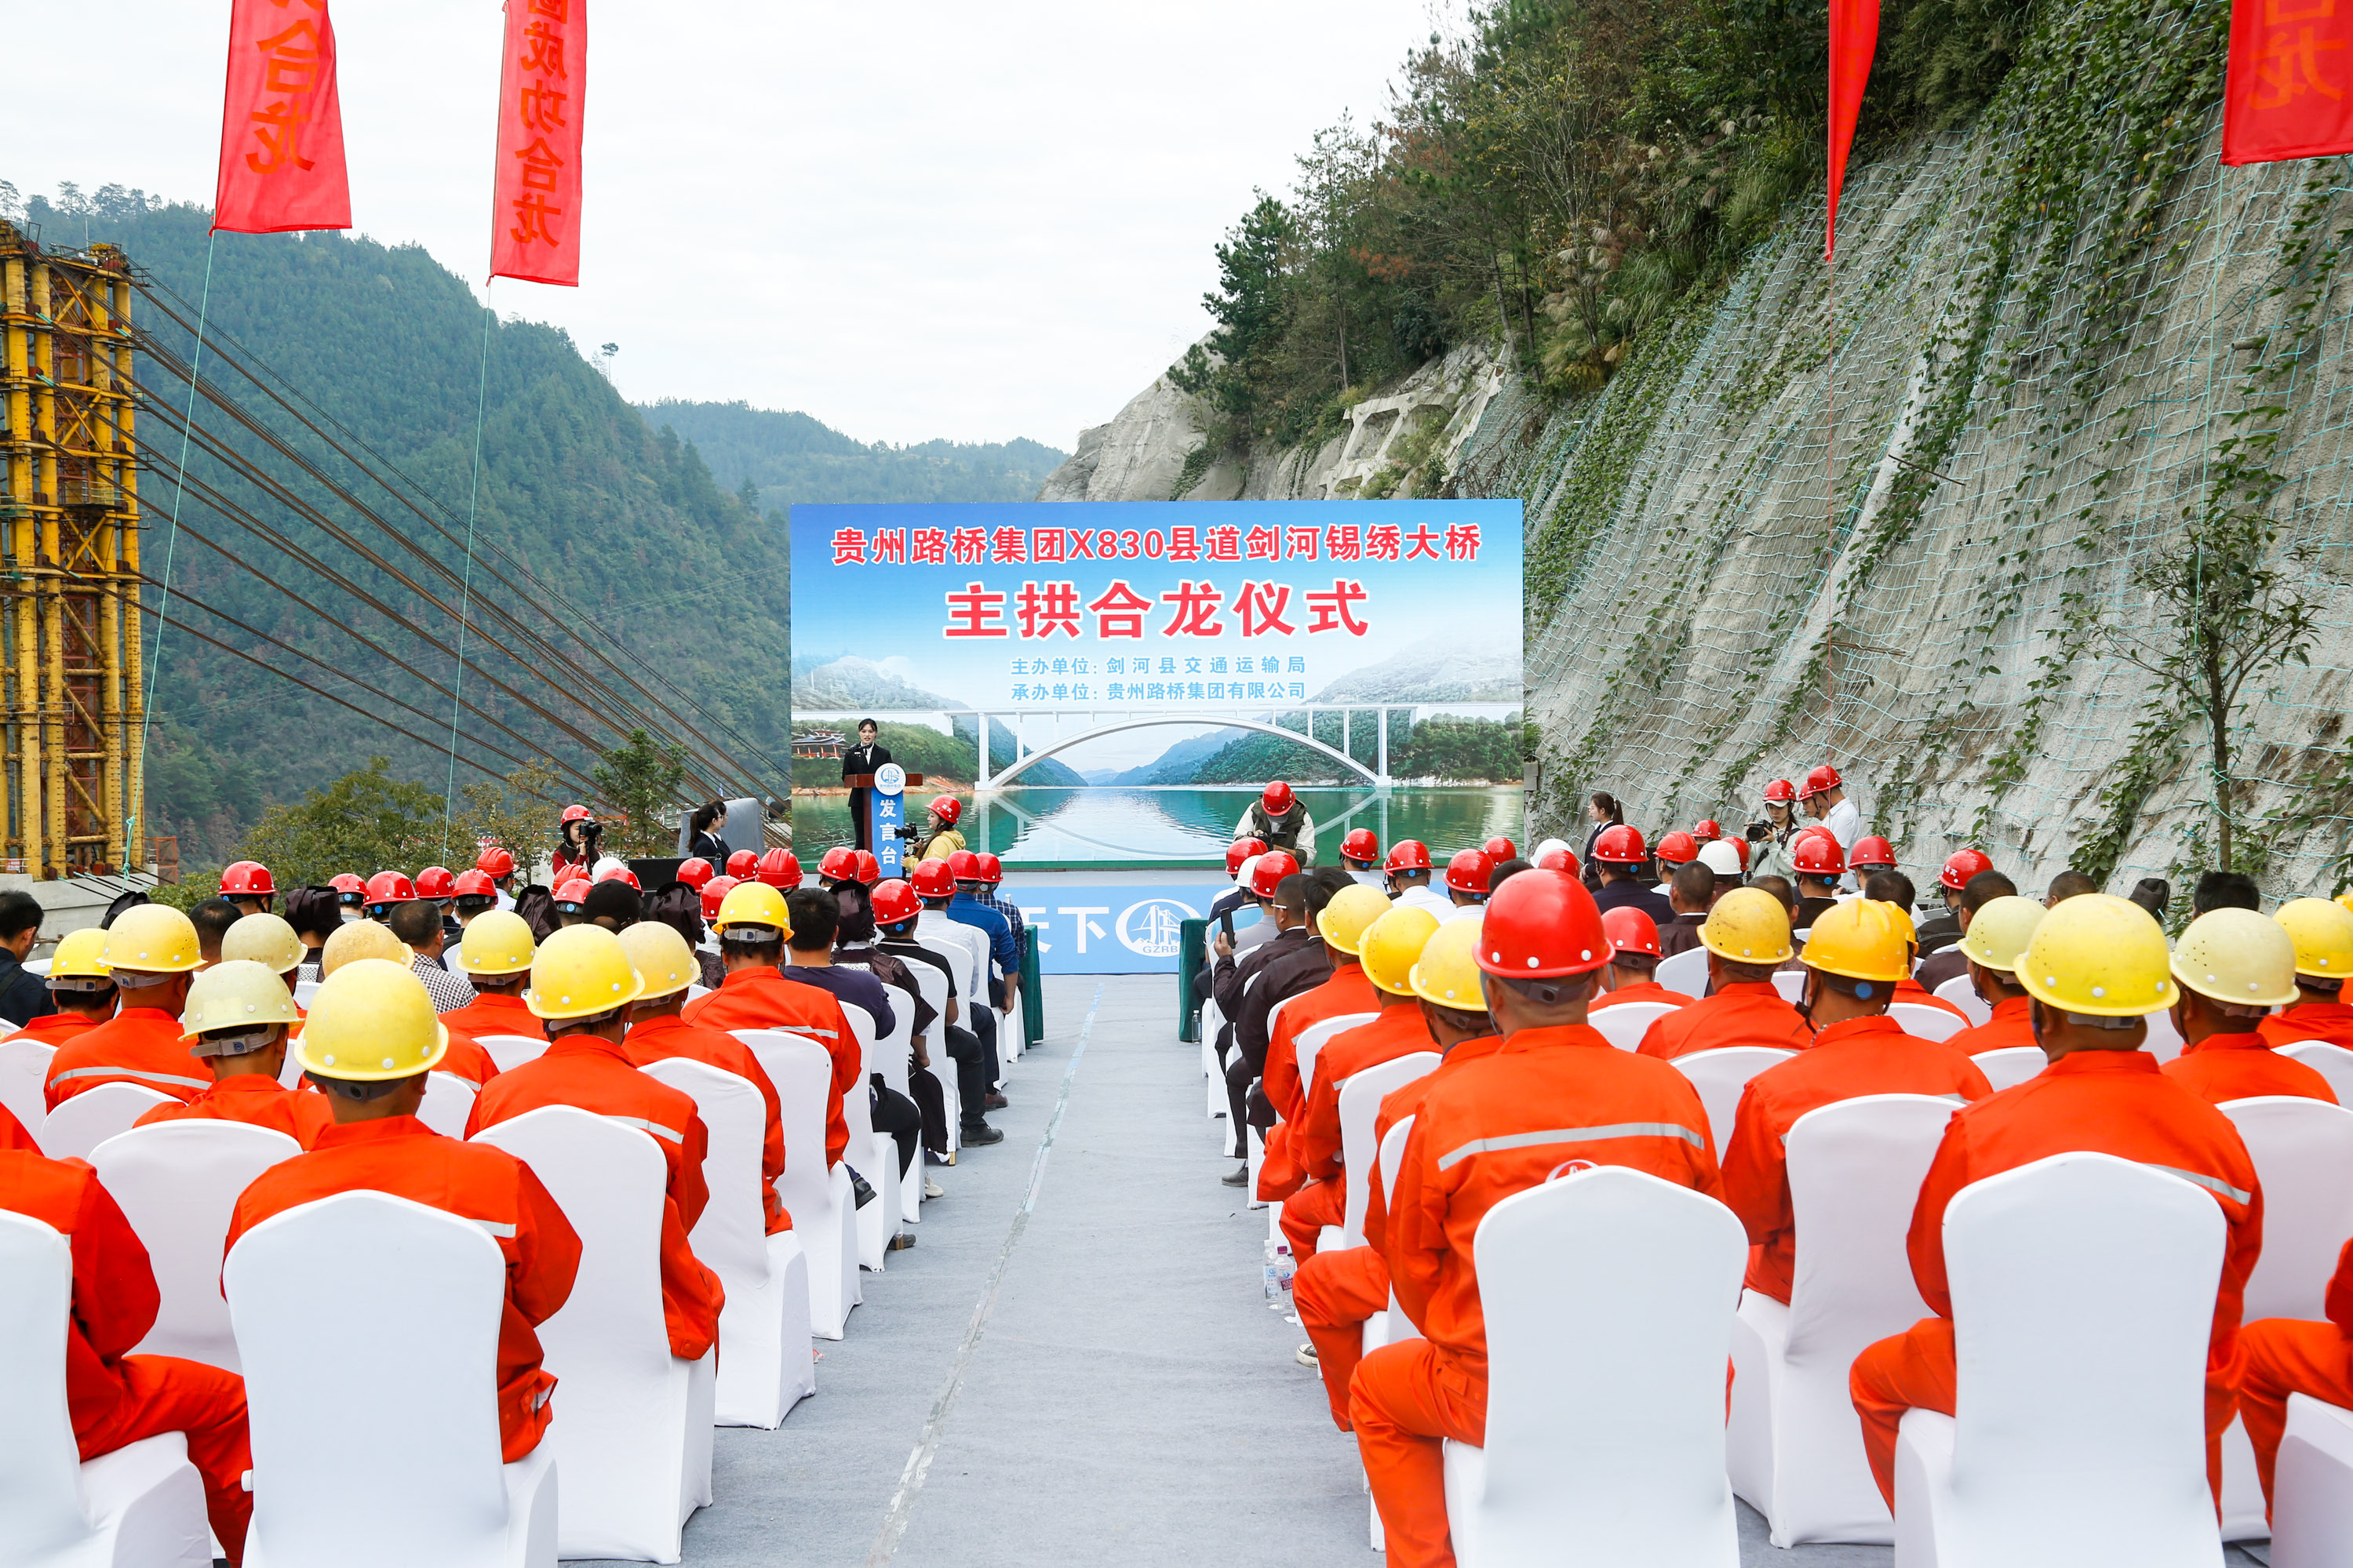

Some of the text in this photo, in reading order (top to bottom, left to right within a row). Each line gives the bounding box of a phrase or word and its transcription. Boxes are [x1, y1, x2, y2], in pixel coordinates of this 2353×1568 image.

[832, 524, 1481, 565] 贵州路桥集团X830县道剑河锡绣大桥
[945, 580, 1369, 638] 主拱合龙仪式
[1011, 681, 1306, 700] 承办单位：贵州路桥集团有限公司
[879, 799, 898, 864] 发言台
